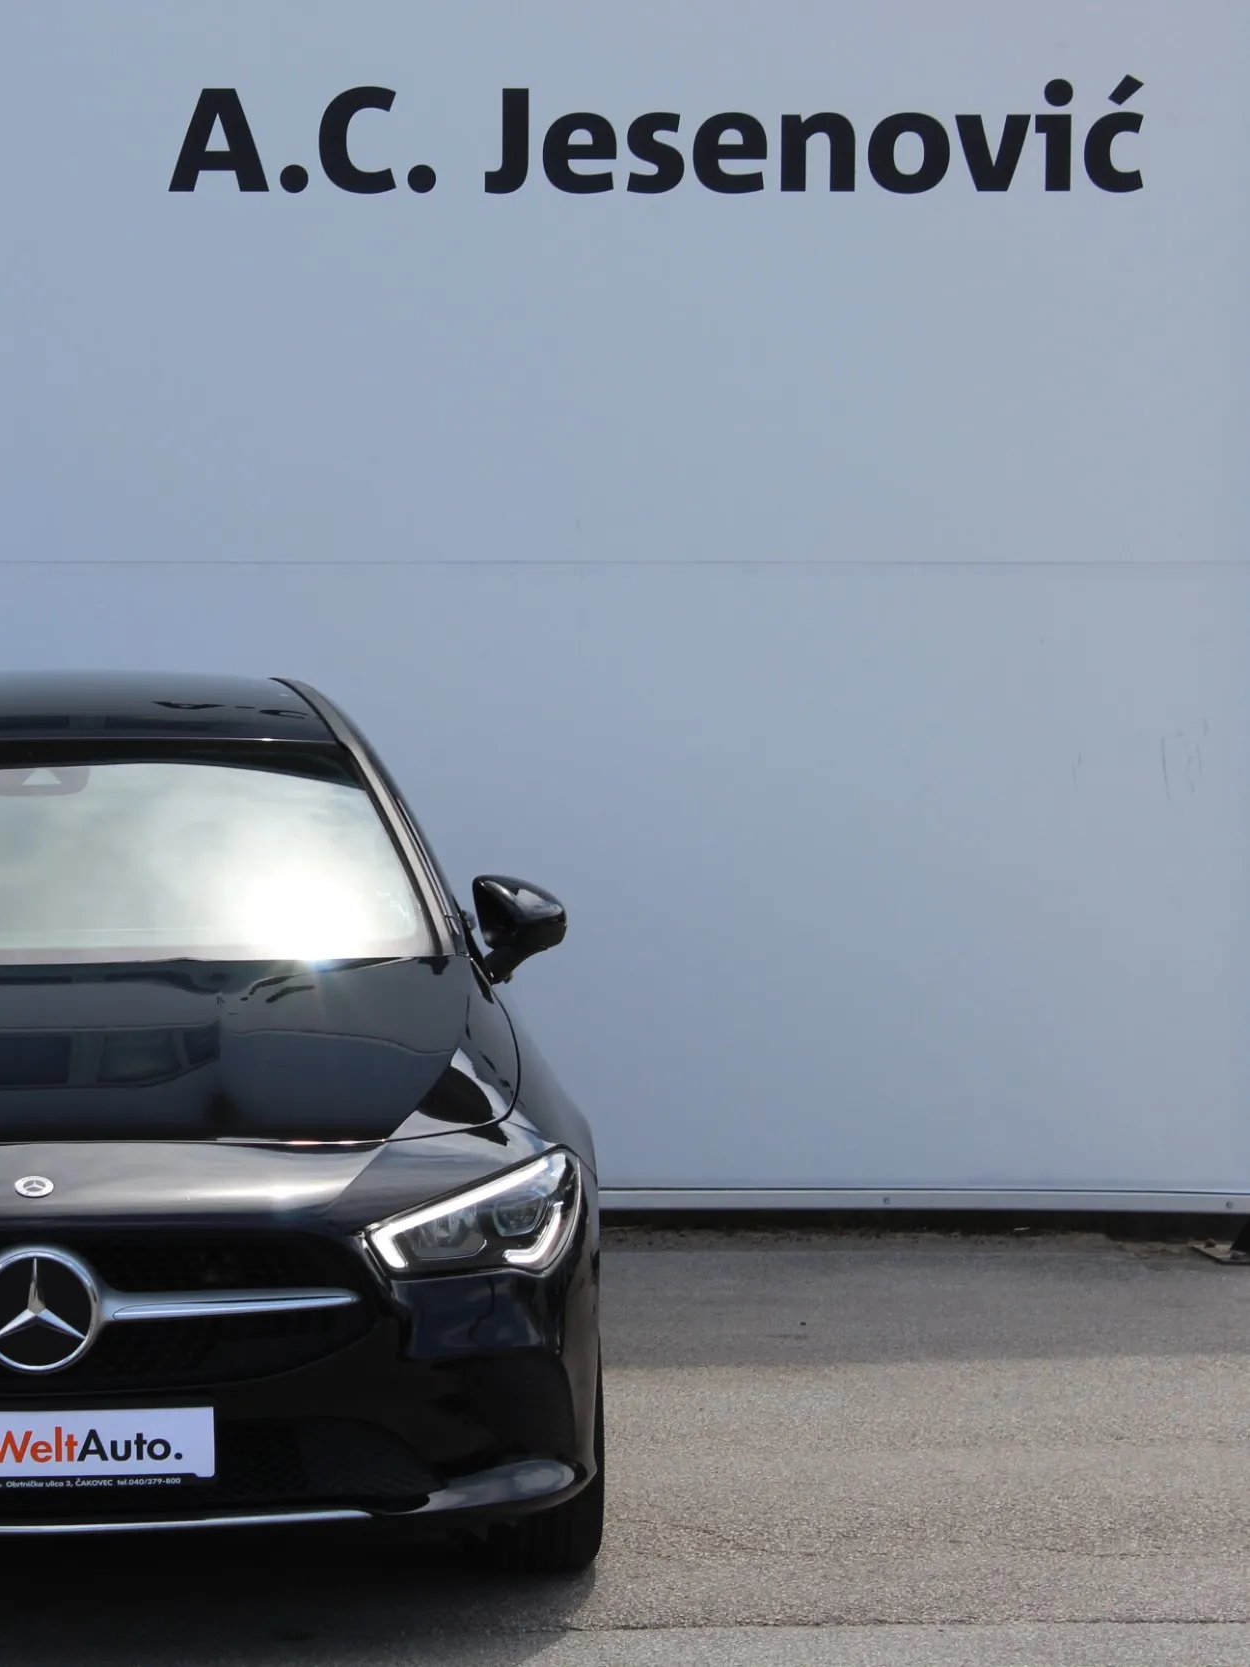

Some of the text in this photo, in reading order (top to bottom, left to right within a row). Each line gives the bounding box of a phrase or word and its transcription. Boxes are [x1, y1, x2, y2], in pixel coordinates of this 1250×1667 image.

[168, 74, 1144, 195] A.C. Jesenović
[5, 1480, 44, 1488] Obrtnička
[45, 1480, 65, 1488] ulica
[74, 1477, 113, 1488] ČAKOVEC
